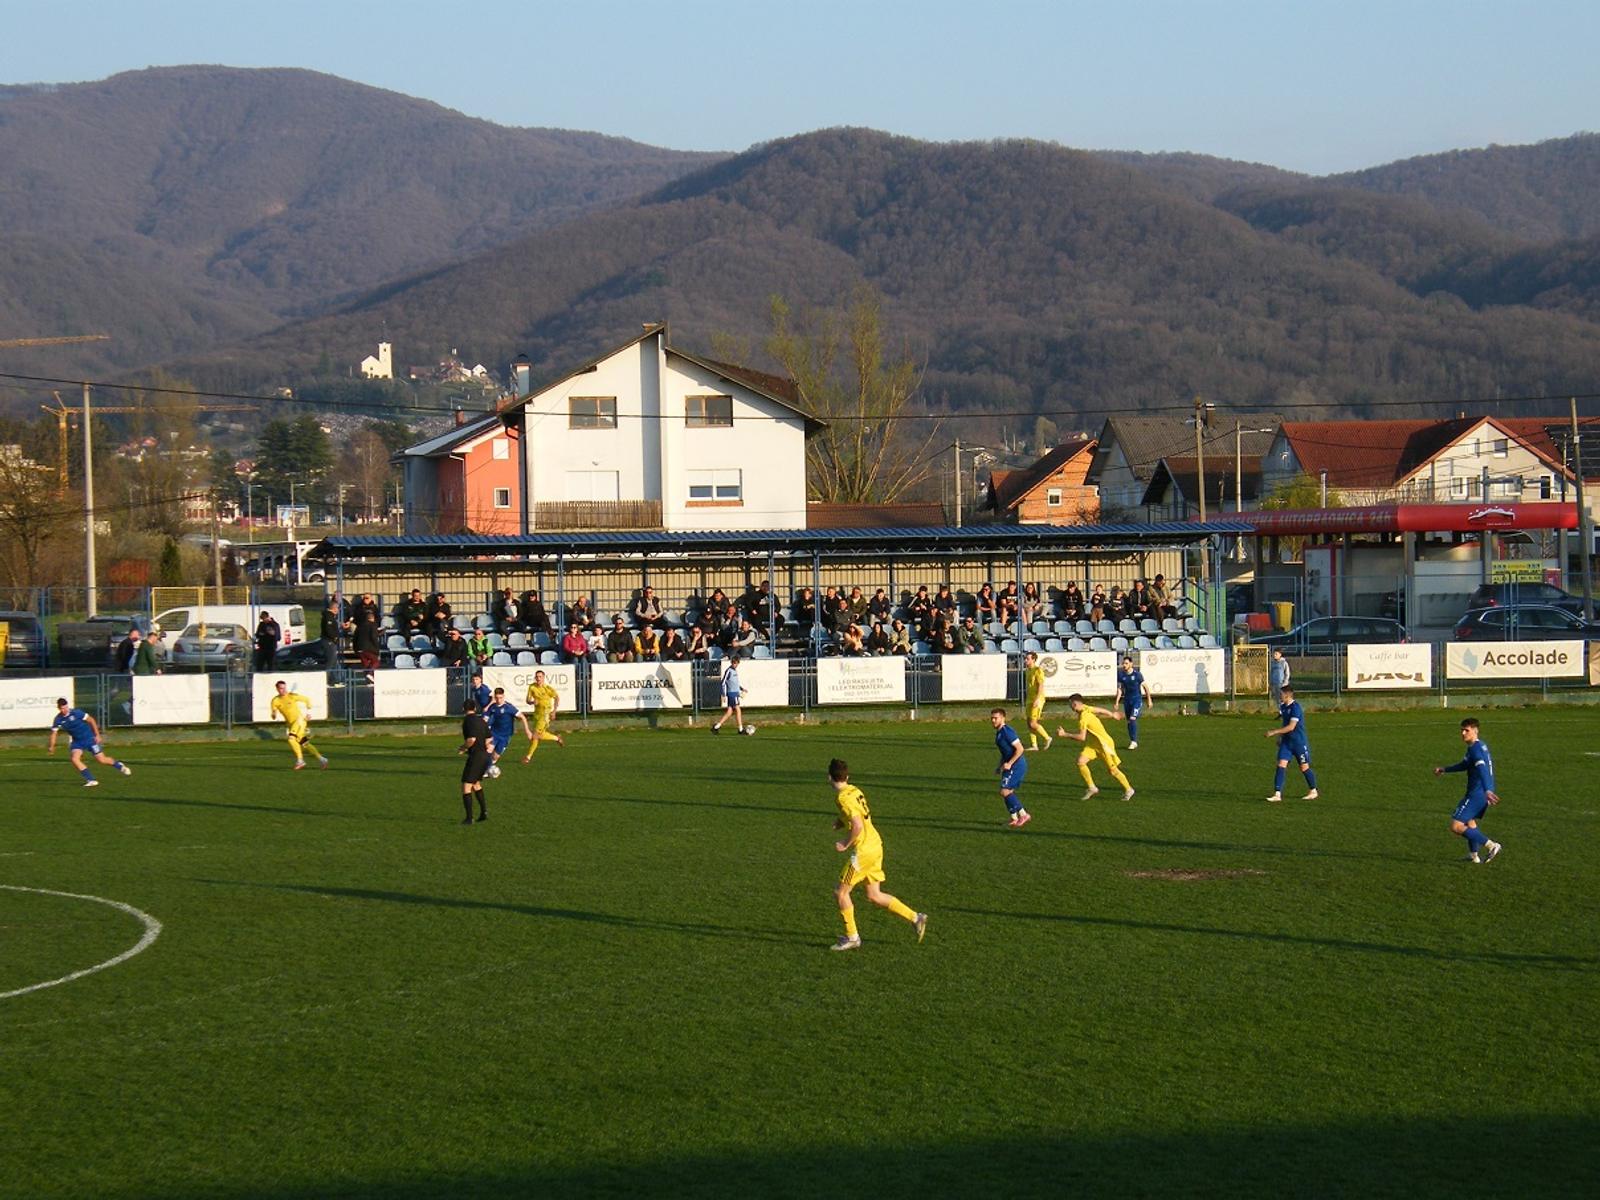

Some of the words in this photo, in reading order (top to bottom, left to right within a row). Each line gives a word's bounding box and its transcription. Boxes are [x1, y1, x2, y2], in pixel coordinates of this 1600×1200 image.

[1483, 649, 1568, 666] Accolade
[513, 673, 569, 687] GEVID
[598, 679, 653, 690] PEKARNA
